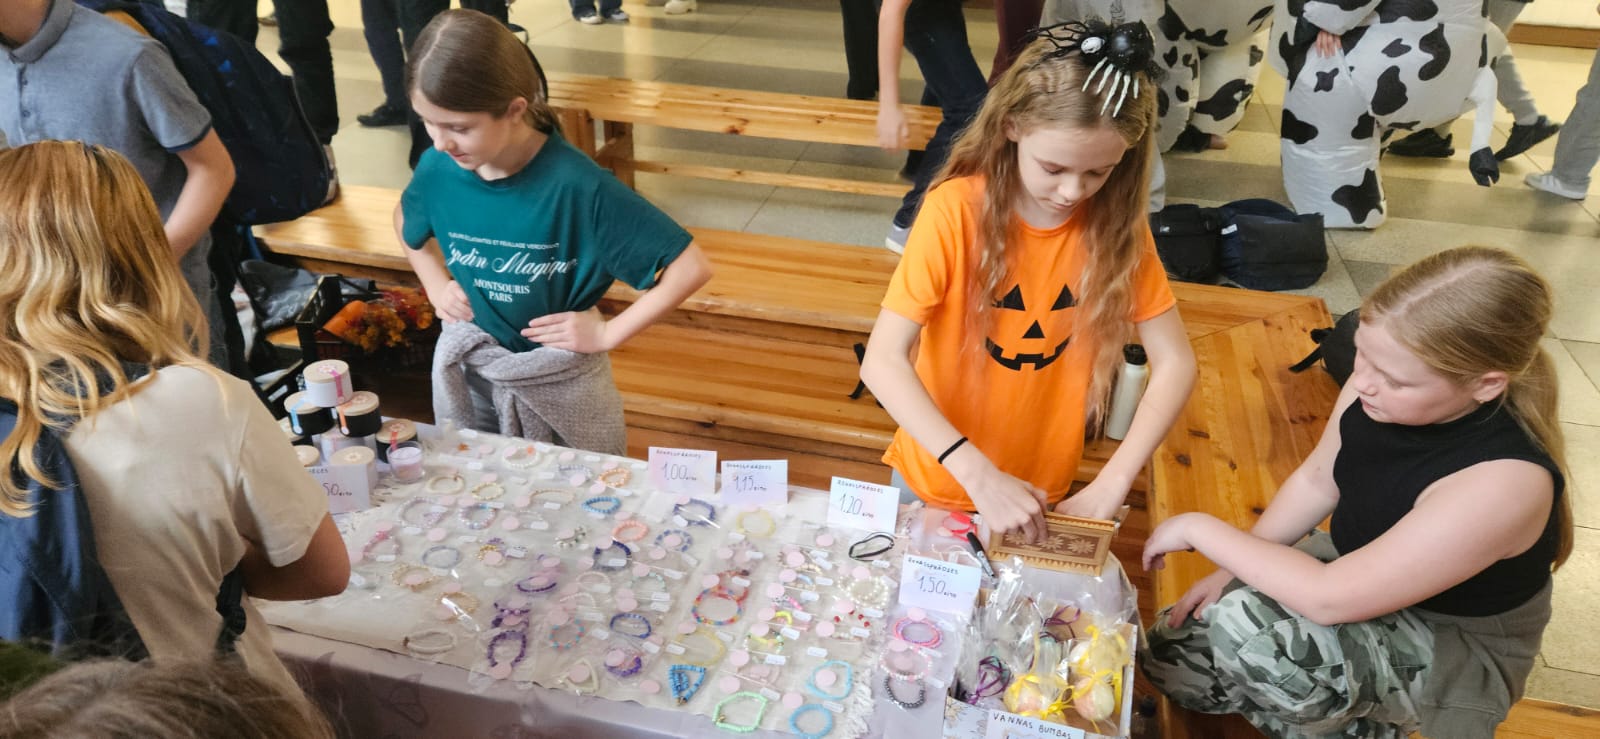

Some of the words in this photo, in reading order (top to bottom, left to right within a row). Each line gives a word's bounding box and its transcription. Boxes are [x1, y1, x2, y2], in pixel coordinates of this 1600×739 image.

[473, 278, 531, 295] MONTSOURIS
[488, 290, 514, 303] PARIS
[993, 712, 1033, 729] VANNAS
[1038, 724, 1072, 739] BUMBAS
